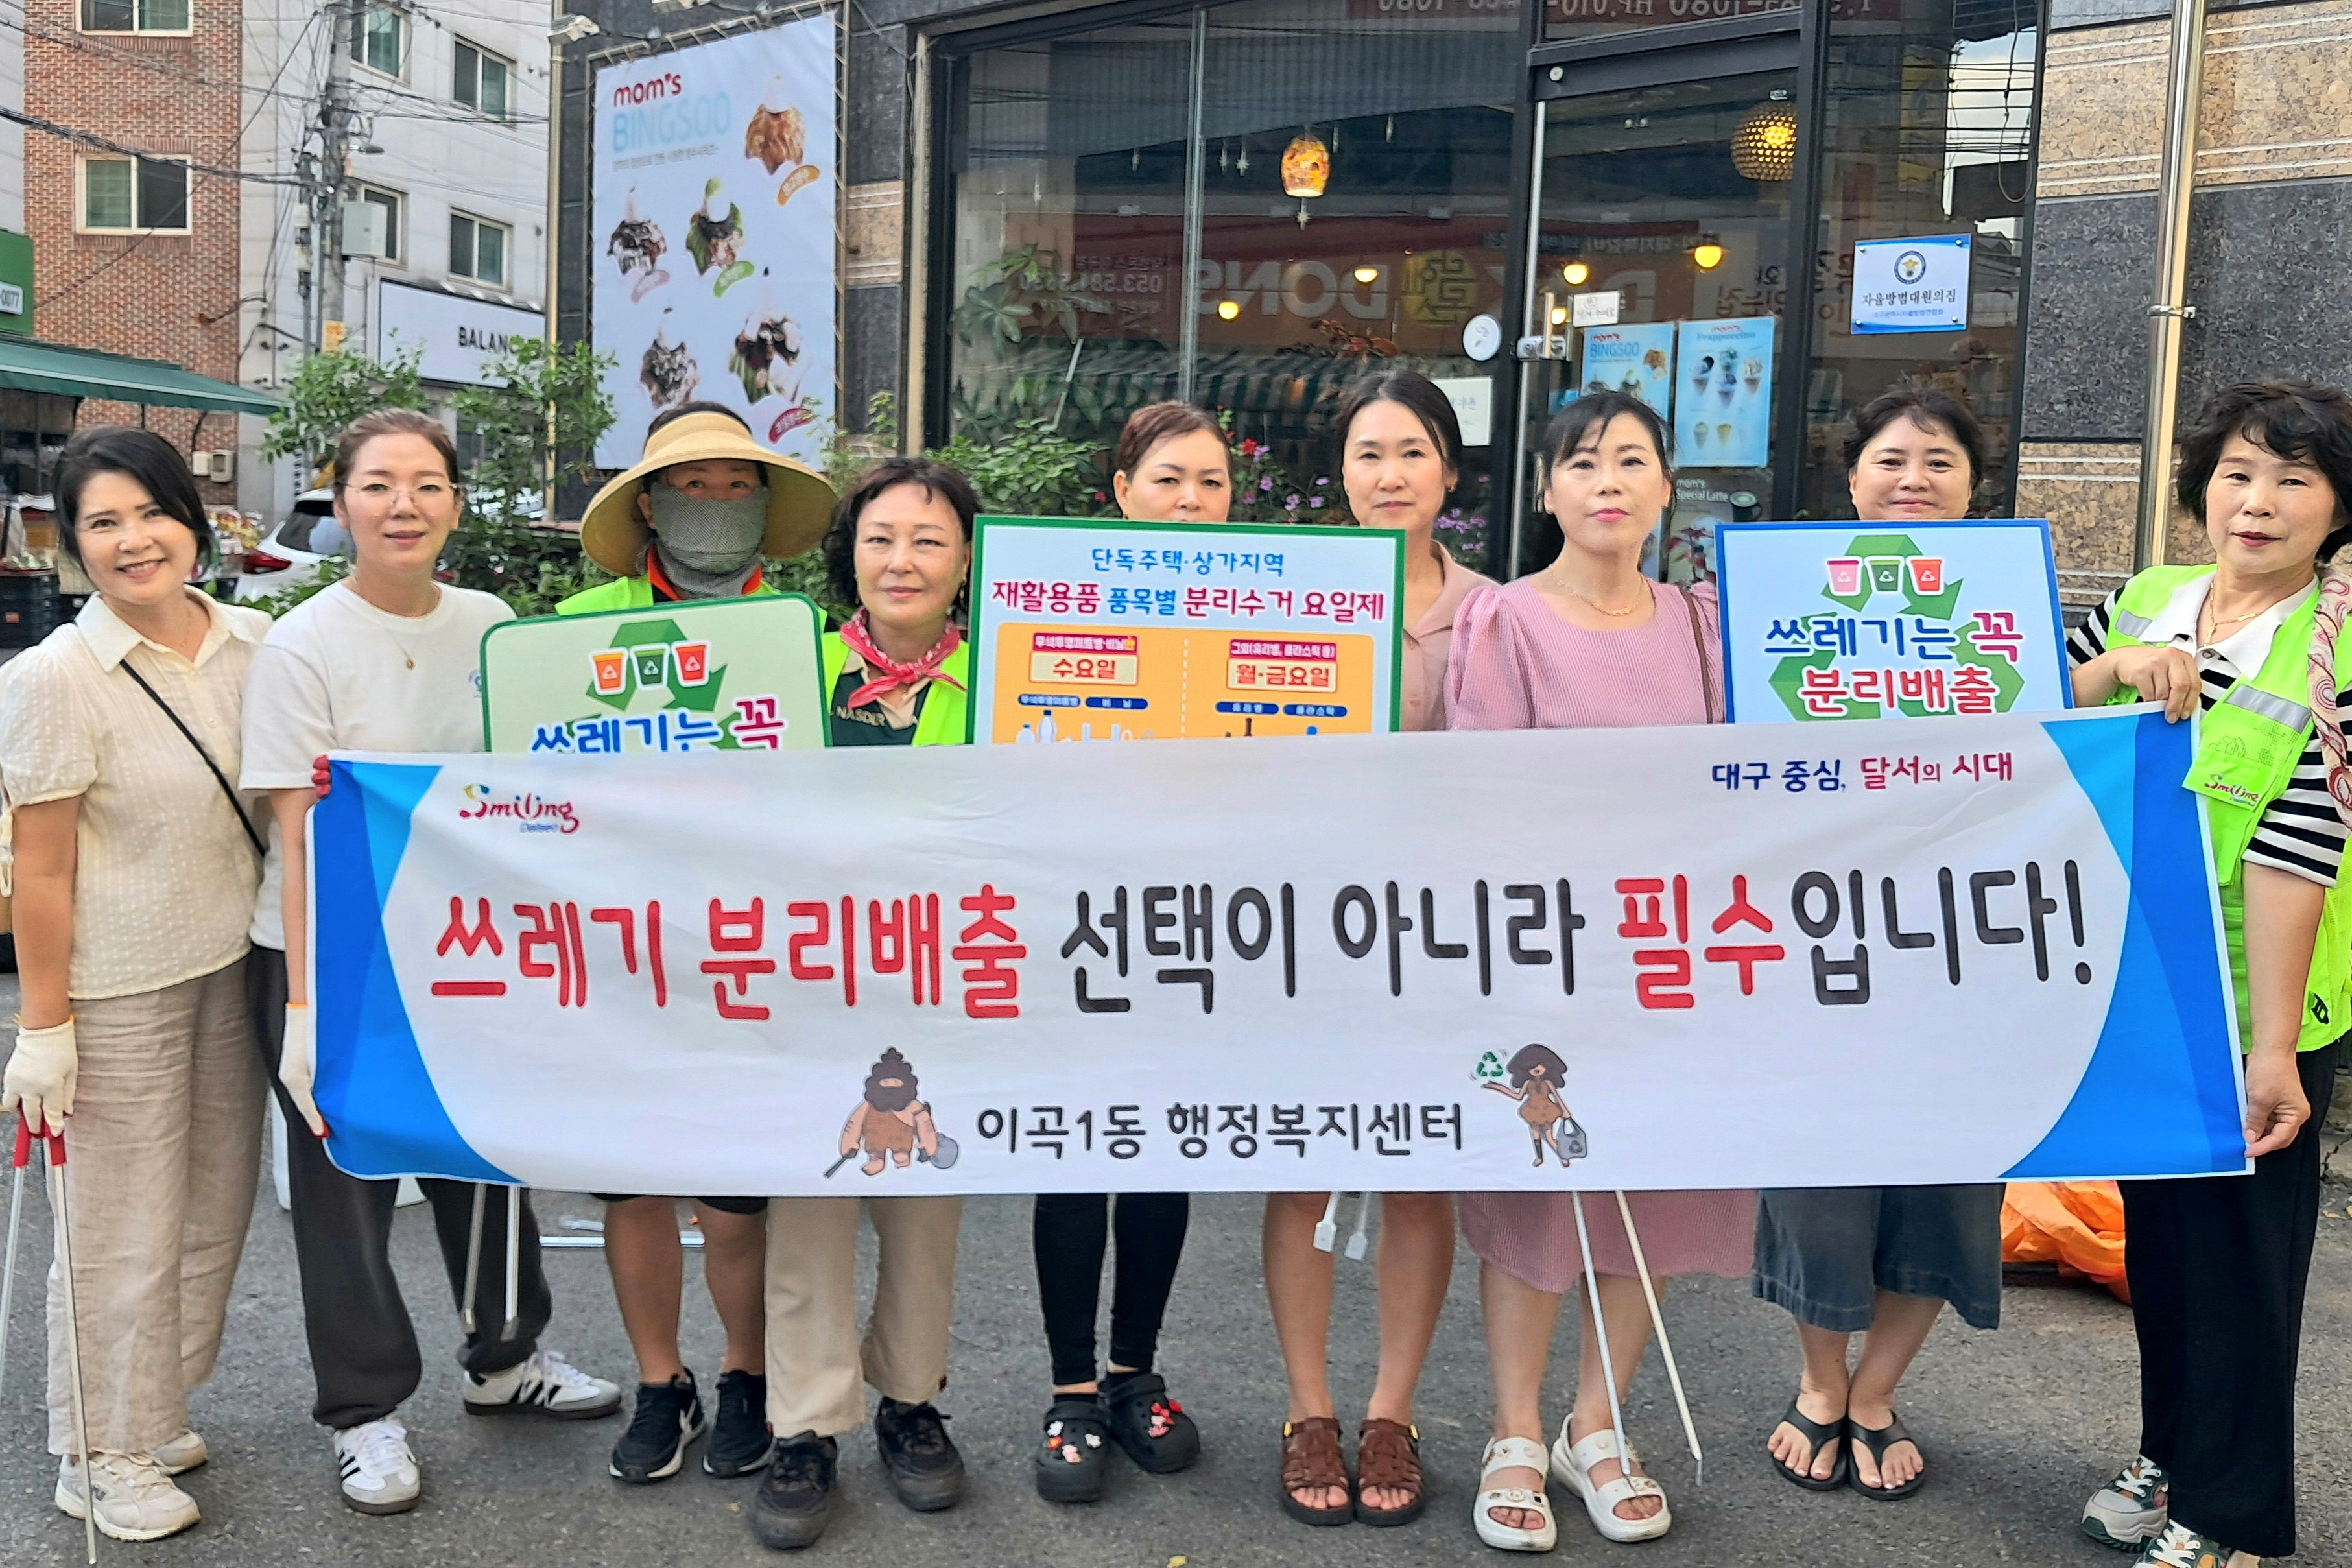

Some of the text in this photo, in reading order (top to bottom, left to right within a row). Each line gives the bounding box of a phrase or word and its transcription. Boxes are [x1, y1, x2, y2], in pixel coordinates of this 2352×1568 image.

[613, 73, 682, 108] mom's
[613, 91, 732, 152] BINGSOO
[1862, 288, 1956, 307] 자율방범대원의집
[458, 326, 517, 355] BALAN
[1590, 342, 1639, 357] BINGSOO
[1676, 488, 1729, 503] Special Latte
[1091, 547, 1284, 577] 단독주택·상가지역
[992, 580, 1384, 622] 재활용품 품목별 분리수거 요일제
[1764, 612, 2024, 663] 쓰레기는 꼭
[1053, 659, 1116, 680] 수요일
[1237, 663, 1329, 687] 월·금요일
[1801, 666, 1996, 715] 분리배출
[531, 713, 719, 752] 쓰레기는
[733, 698, 784, 751] 꼭
[1711, 751, 2012, 793] 대구 중심, 달서의 시대
[459, 782, 580, 835] Smiling
[430, 859, 2093, 1021] 쓰레기 분리배출 선택이 아니라 필수입니다!
[975, 1101, 1463, 1161] 이곡1동 행정복지센터
